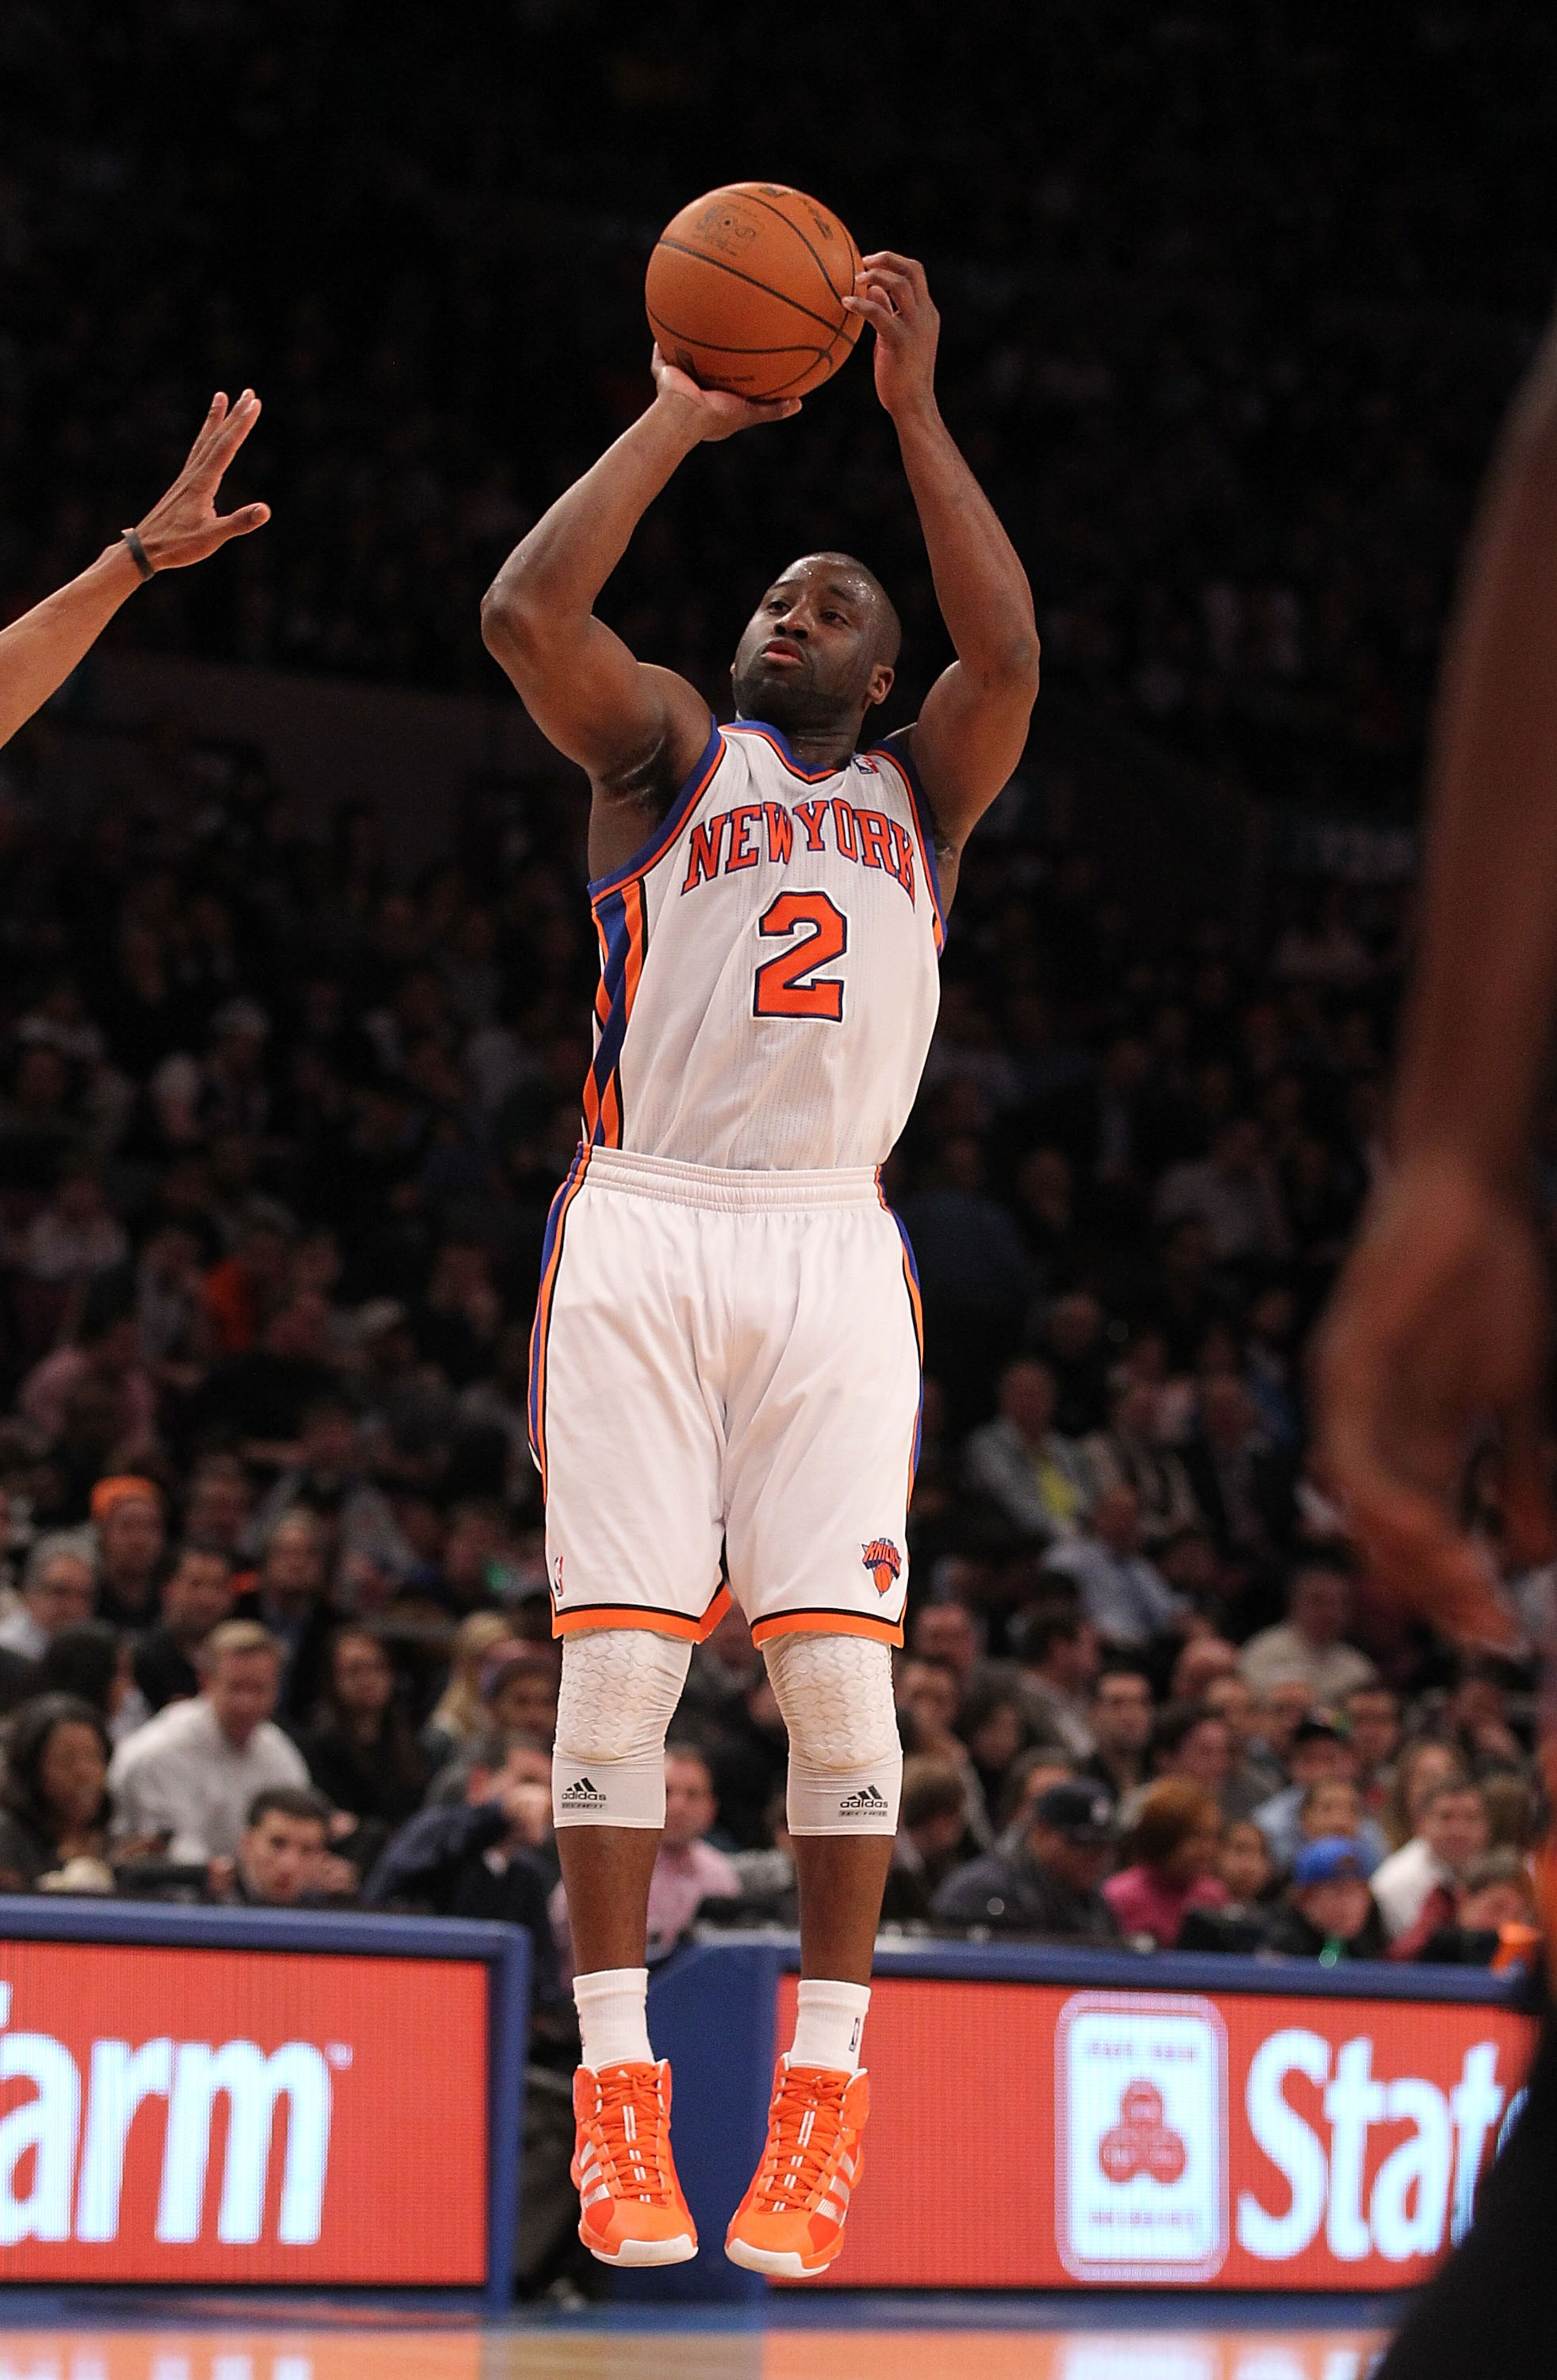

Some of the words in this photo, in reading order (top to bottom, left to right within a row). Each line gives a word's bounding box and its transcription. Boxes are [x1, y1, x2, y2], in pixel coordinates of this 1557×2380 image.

[680, 801, 793, 896] NEW
[792, 798, 915, 913] YORK
[753, 891, 847, 1023] 2
[562, 1791, 607, 1801] adidas
[840, 1799, 888, 1808] adidas
[0, 1981, 334, 2247] arm
[1237, 2029, 1529, 2262] Stat
